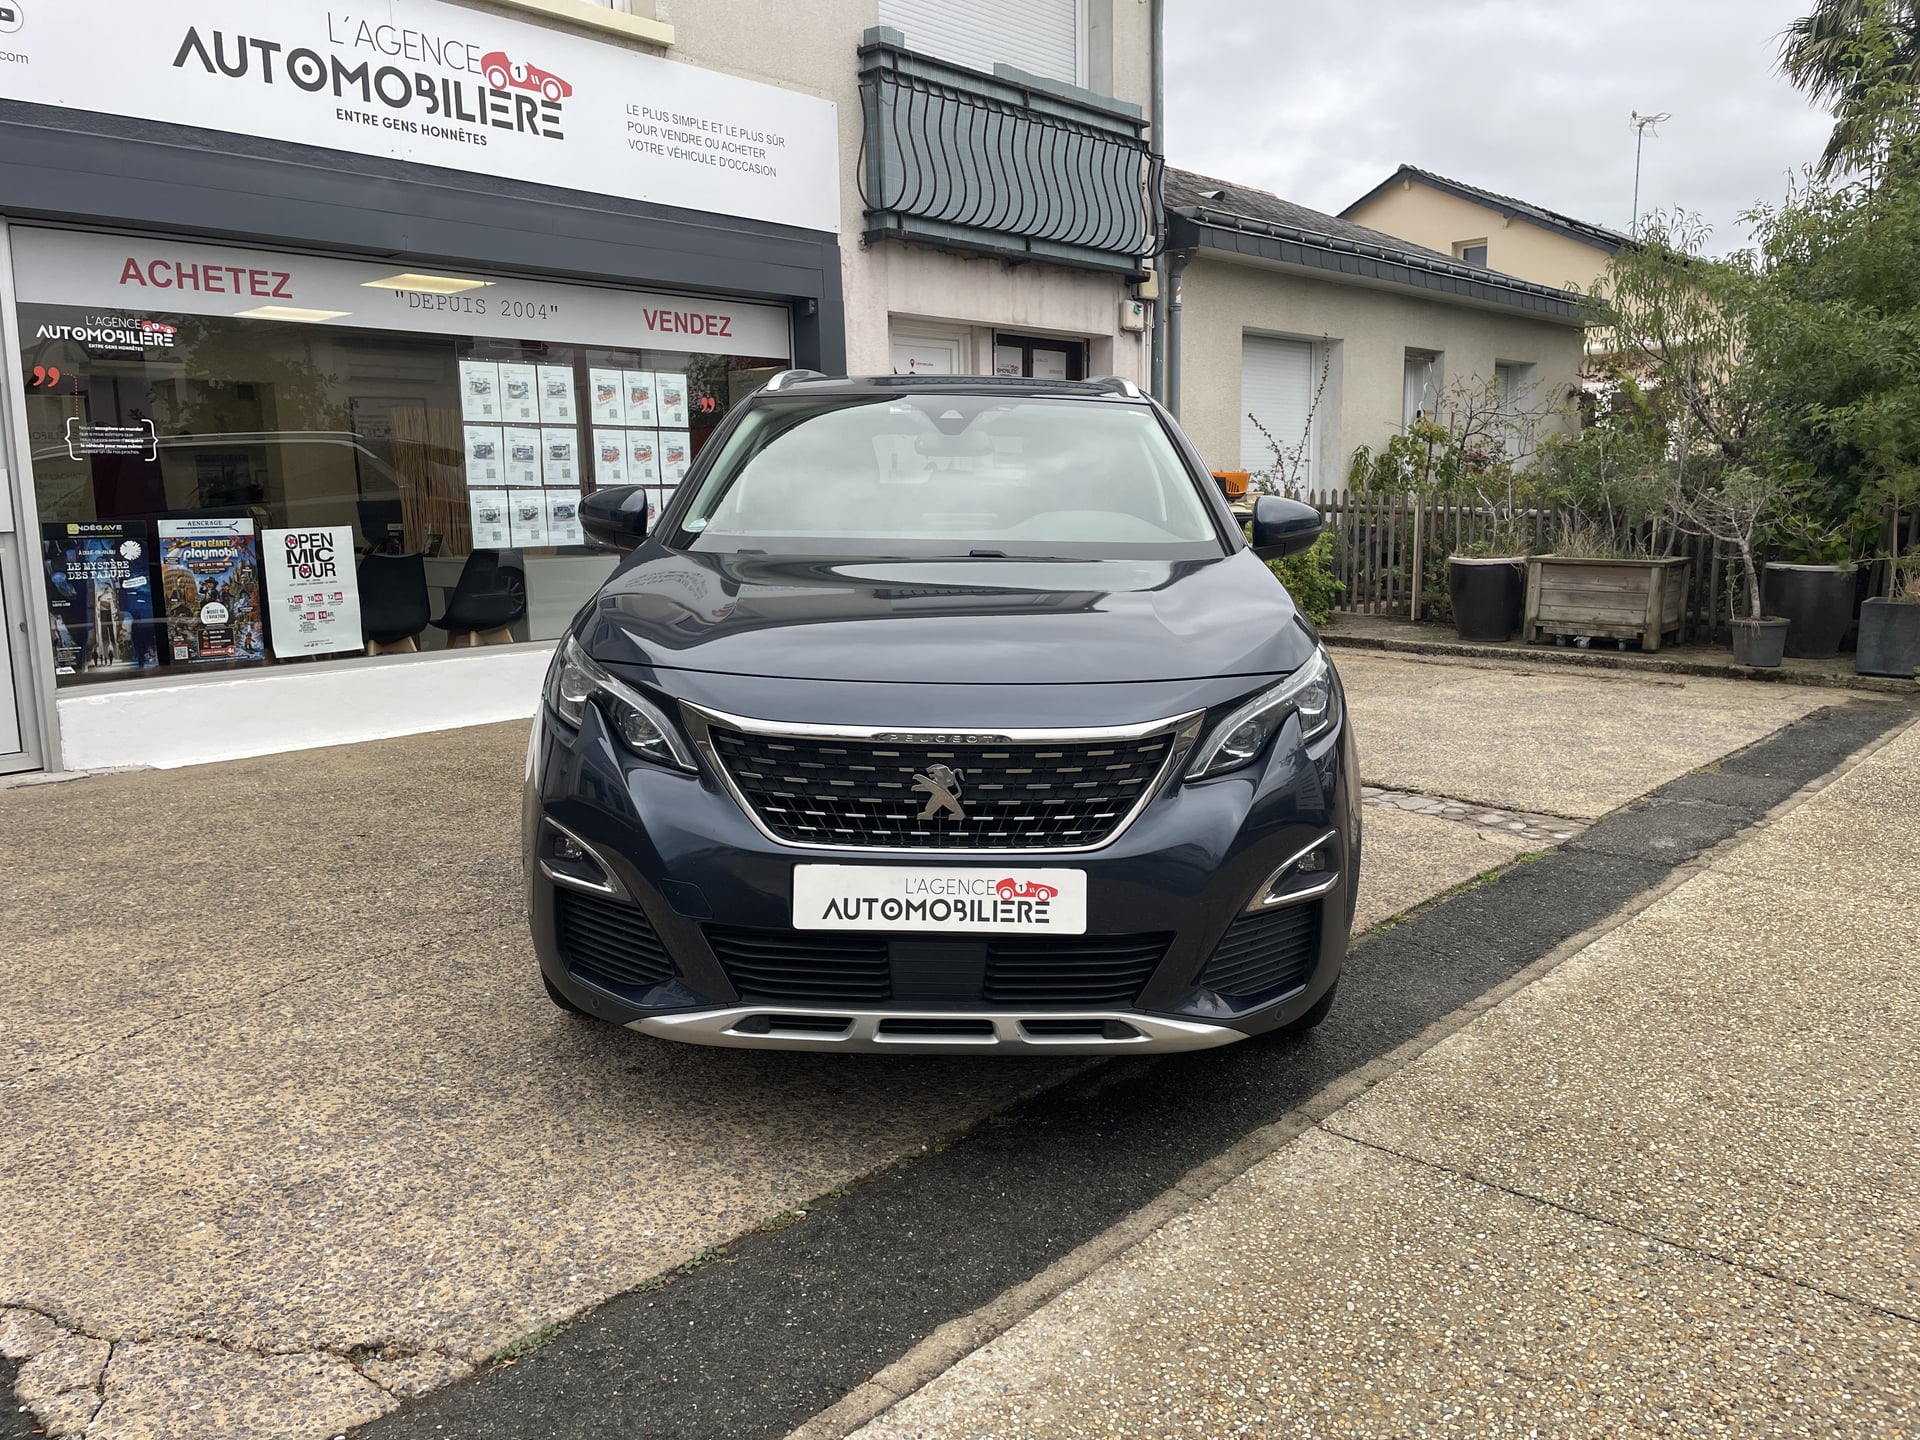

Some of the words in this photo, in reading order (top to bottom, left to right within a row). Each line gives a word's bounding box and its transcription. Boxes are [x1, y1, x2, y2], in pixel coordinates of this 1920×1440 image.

[327, 12, 482, 75] L'AGENCE
[336, 108, 378, 127] ENTRE
[382, 117, 418, 134] GENS
[421, 124, 488, 146] HONNÊTES
[626, 103, 640, 116] LE
[642, 107, 669, 123] PLUS
[672, 113, 709, 131] SIMPLE
[711, 122, 723, 134] ET
[726, 126, 738, 137] LE
[740, 129, 764, 143] PLUS
[766, 133, 786, 148] SÛR
[627, 121, 658, 137] POUR
[660, 128, 702, 147] VENDRE
[704, 137, 719, 150] OU
[721, 141, 766, 159] ACHETER
[628, 139, 664, 156] VOTRE
[666, 145, 717, 166] VÉHICULE
[719, 156, 777, 177] D'OCCASION
[119, 257, 293, 299] ACHETEZ
[85, 315, 141, 330] L'AGENCE
[643, 308, 732, 338] VENDEZ
[190, 540, 207, 548] EXPO
[207, 539, 231, 547] GÉANTE
[284, 532, 334, 549] OPEN
[183, 547, 238, 560] playmobil
[286, 547, 334, 564] MIC
[66, 562, 82, 571] LE
[83, 559, 130, 571] MYSTÈRE
[287, 562, 336, 579] TOUR
[67, 571, 89, 580] DES
[90, 570, 131, 579] FALUNS
[889, 733, 993, 743] PEUGEOT
[905, 878, 996, 896] L'AGENCE
